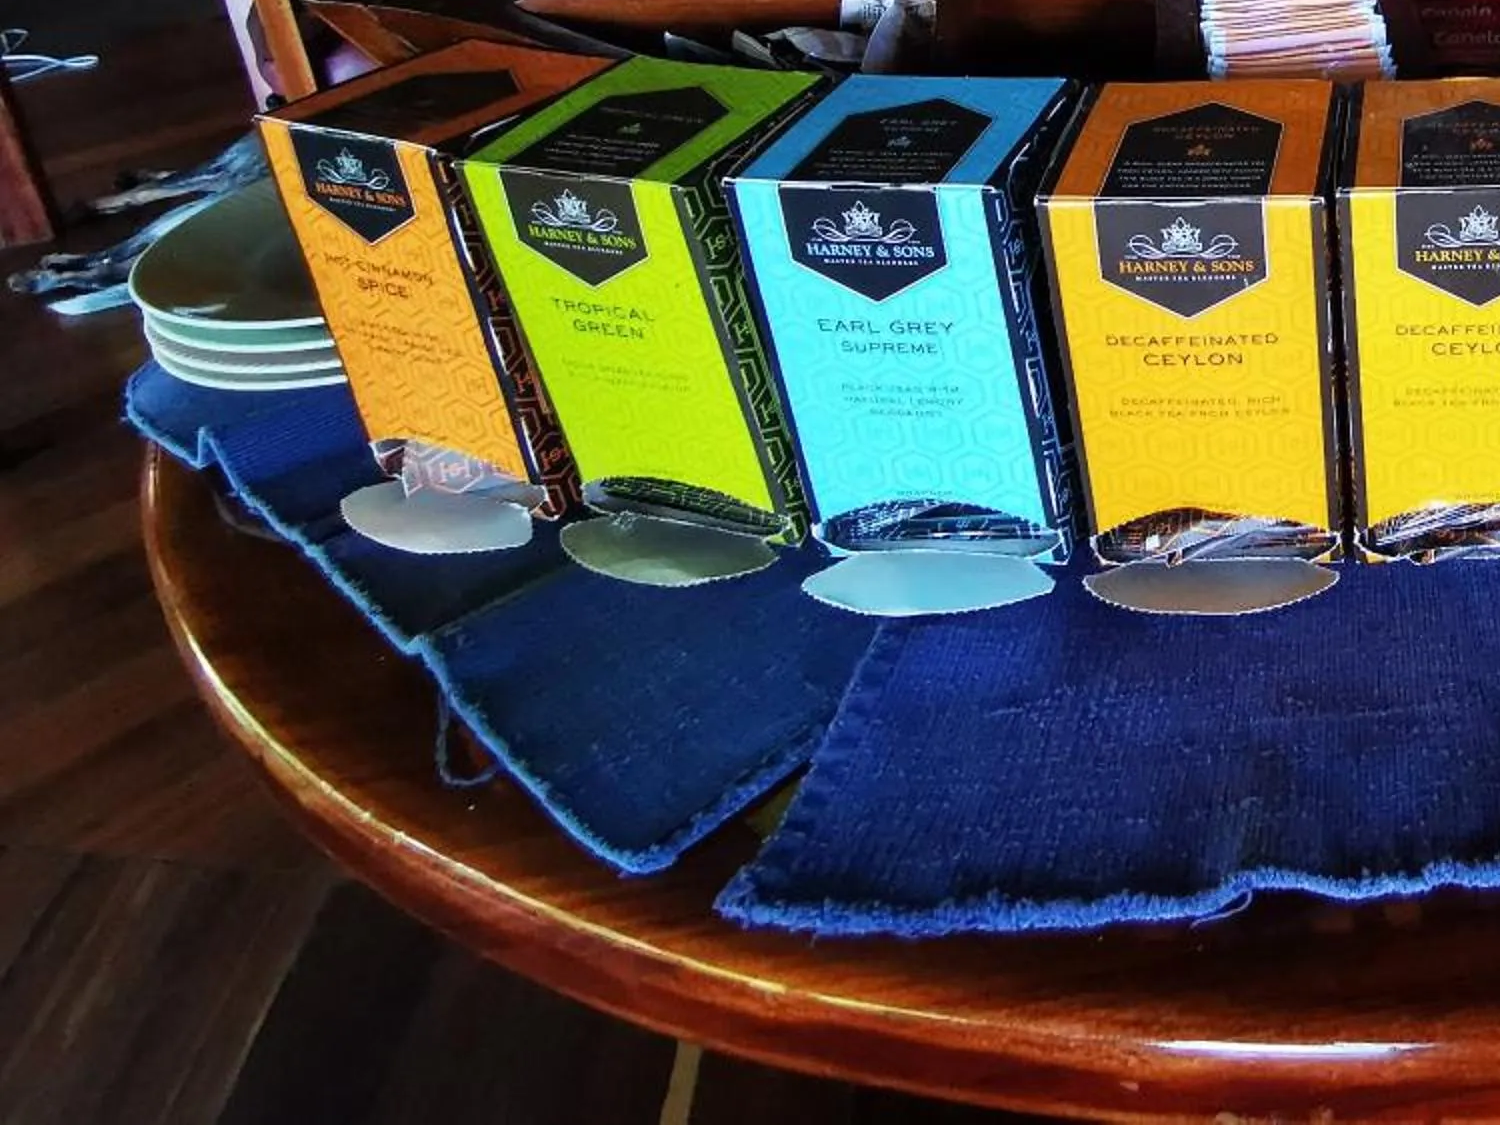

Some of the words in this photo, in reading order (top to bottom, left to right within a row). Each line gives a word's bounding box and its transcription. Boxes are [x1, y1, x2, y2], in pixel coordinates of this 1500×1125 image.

[315, 181, 362, 199] HARNEY
[528, 224, 582, 242] HARNEY
[587, 233, 598, 245] &
[601, 235, 637, 250] SONS
[806, 243, 872, 257] HARNEY
[876, 245, 890, 257] &
[893, 246, 935, 258] SONS
[1415, 250, 1483, 262] HARNEY
[1487, 249, 1500, 261] &
[1120, 260, 1188, 273] HARNEY
[1193, 261, 1206, 273] &
[1211, 260, 1255, 273] SONS
[356, 276, 409, 299] SPICE
[553, 298, 655, 322] TROPICAL
[573, 318, 643, 339] GREEN
[817, 318, 880, 334] EARL
[889, 319, 954, 336] GREY
[841, 340, 938, 355] SUPREME
[1105, 333, 1278, 347] DECAFFEINATED
[1143, 353, 1243, 366] CEYLON
